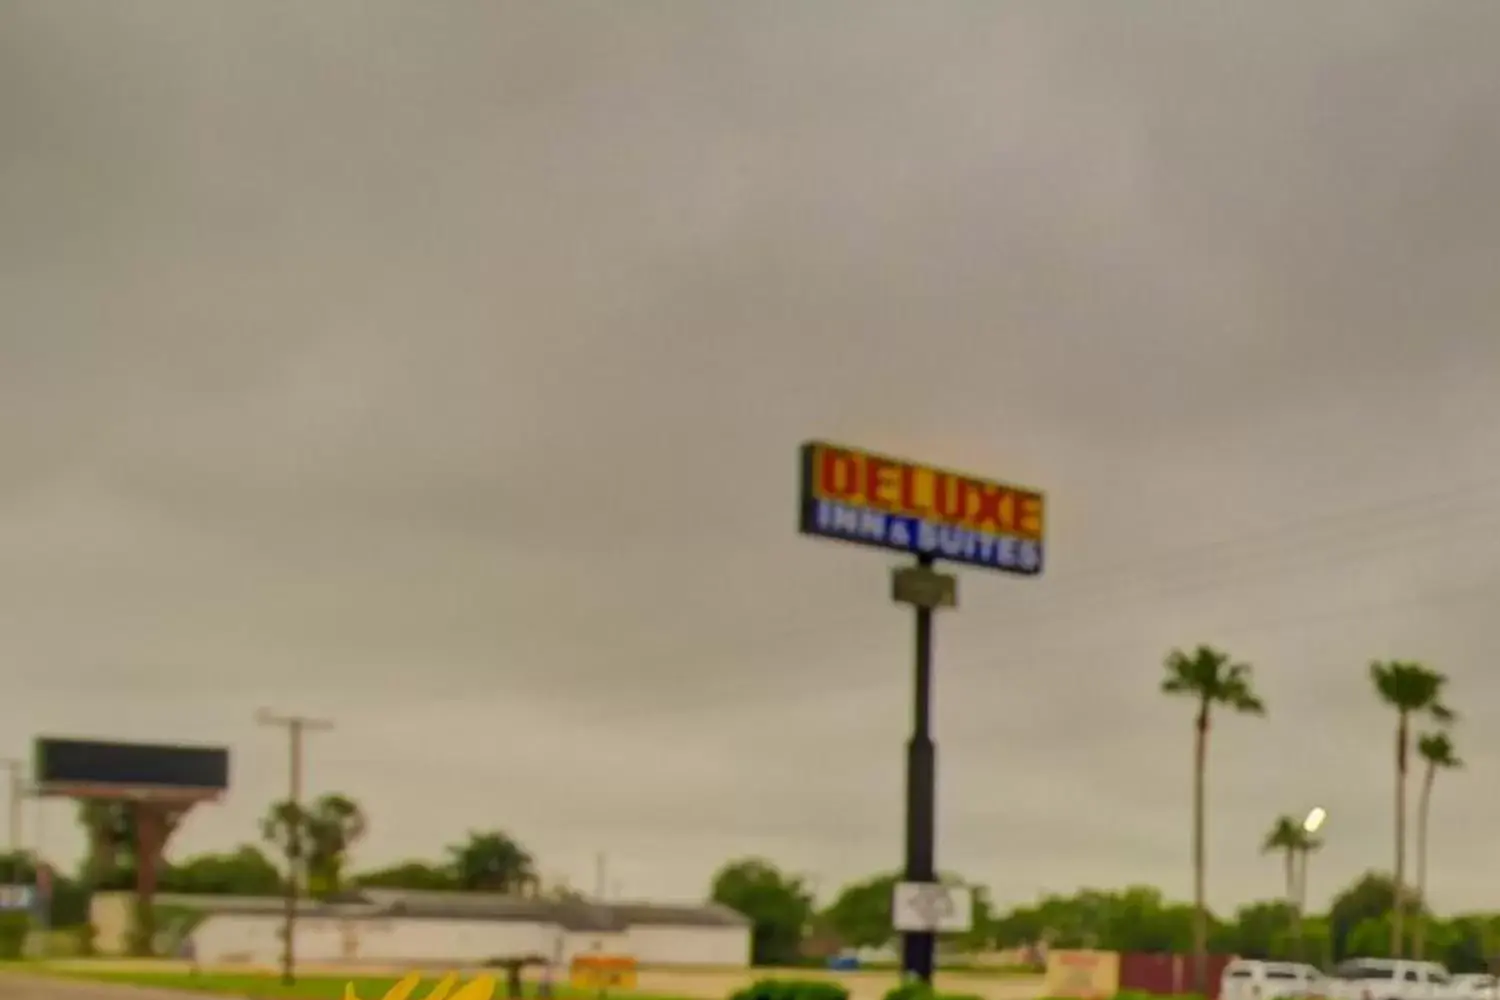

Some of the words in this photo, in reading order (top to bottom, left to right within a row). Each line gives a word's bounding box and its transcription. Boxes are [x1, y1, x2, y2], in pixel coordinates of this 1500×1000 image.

[820, 447, 1042, 534] DELUXE
[816, 501, 886, 541] INN
[917, 516, 1040, 570] SUITES
